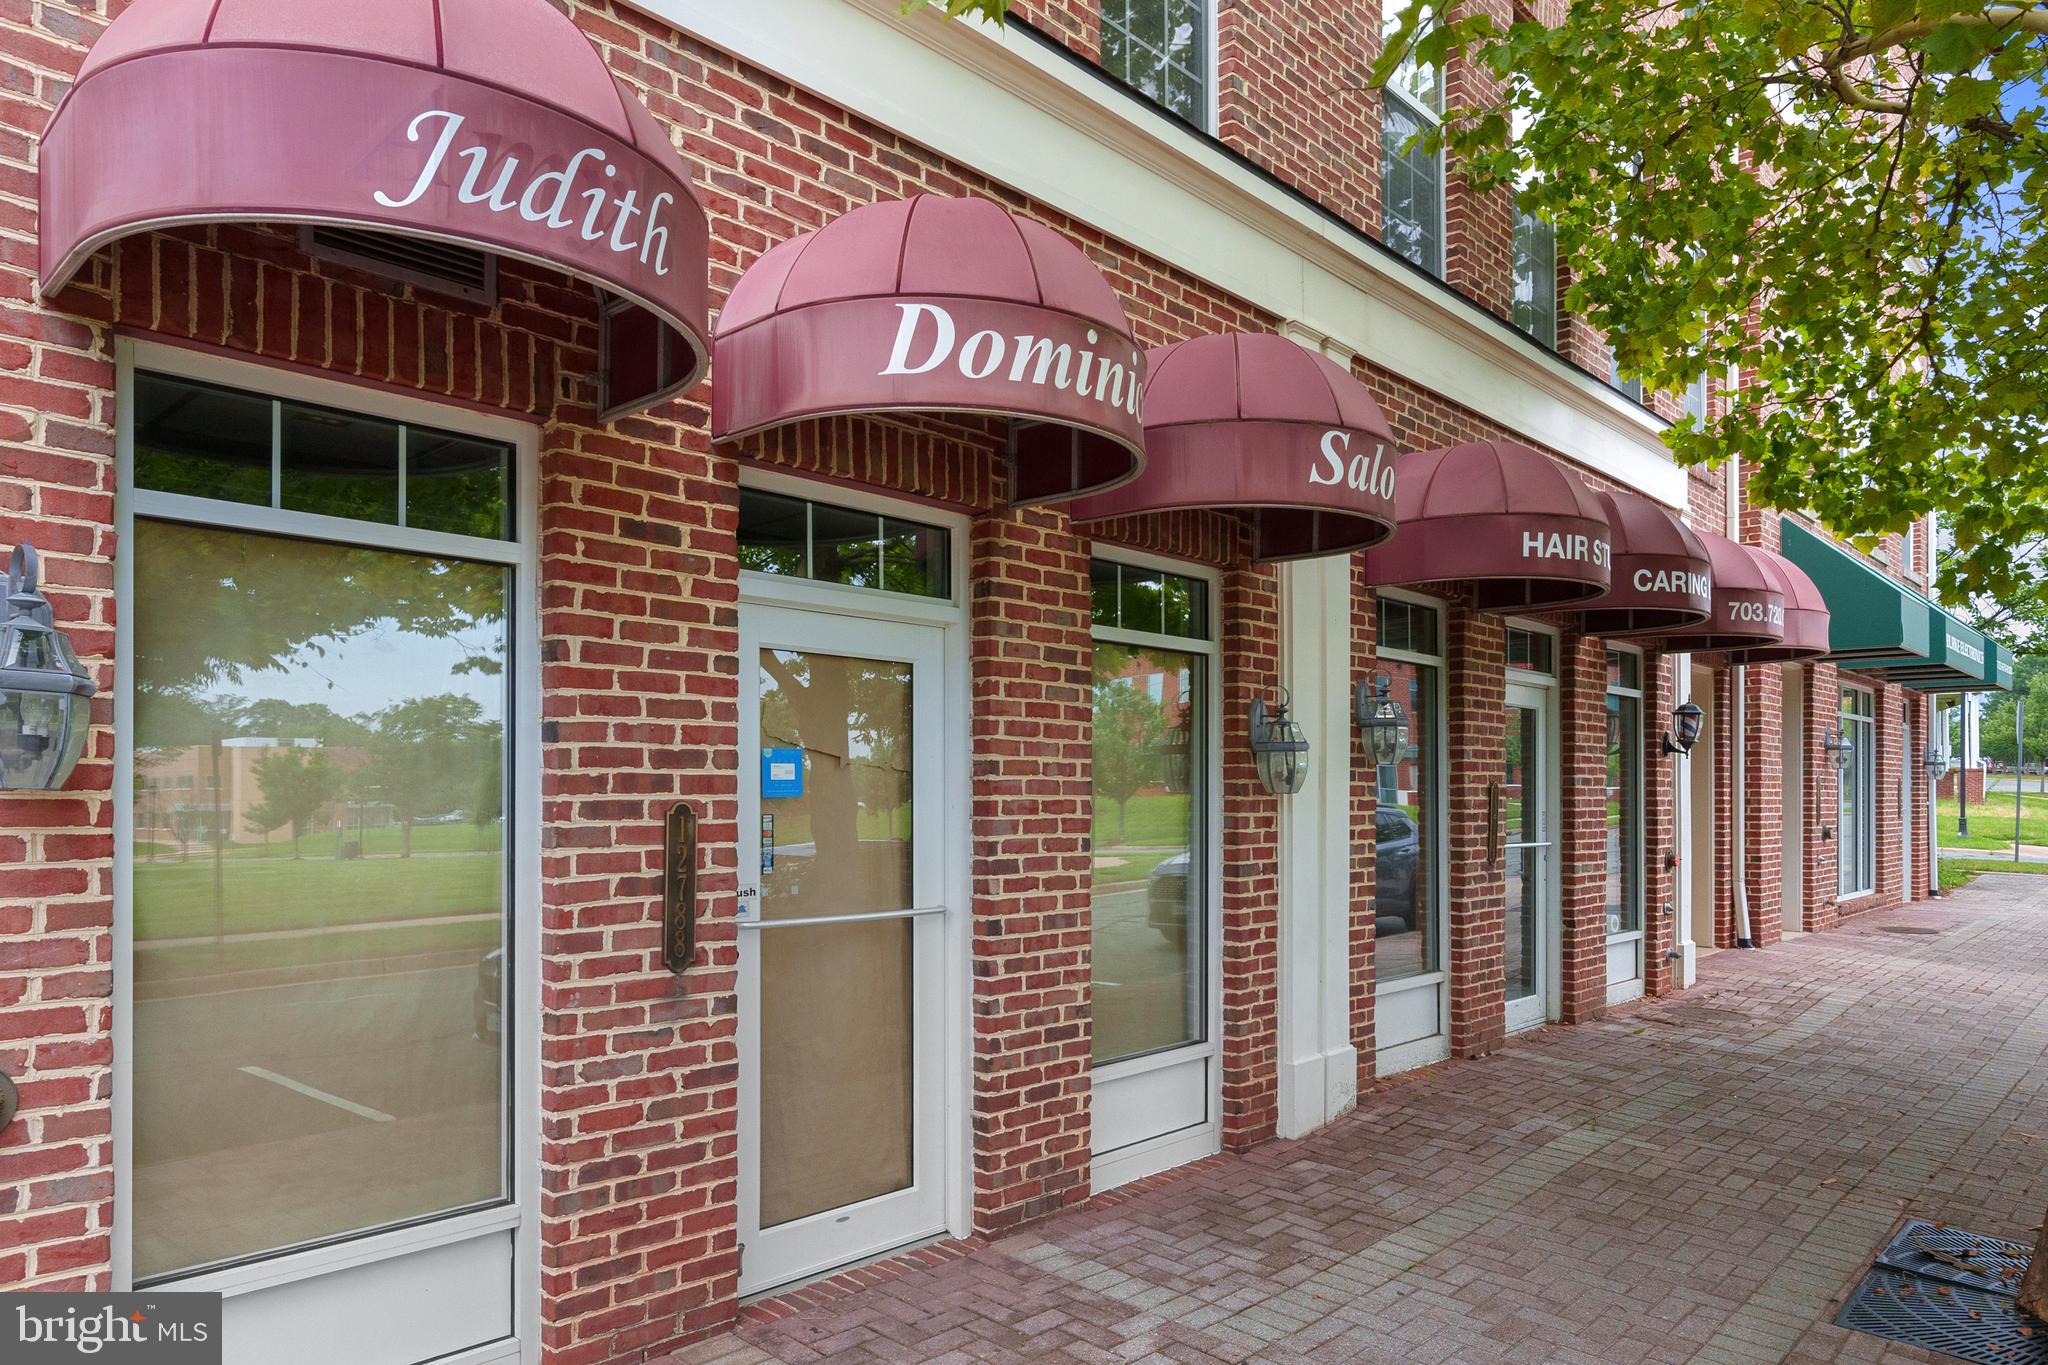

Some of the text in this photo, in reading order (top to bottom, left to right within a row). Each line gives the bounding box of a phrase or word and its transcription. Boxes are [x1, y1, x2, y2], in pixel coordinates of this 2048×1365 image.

[373, 110, 674, 276] Judith
[1309, 430, 1397, 505] Salo
[1523, 531, 1588, 562] HAIR
[1633, 568, 1708, 598] CARING
